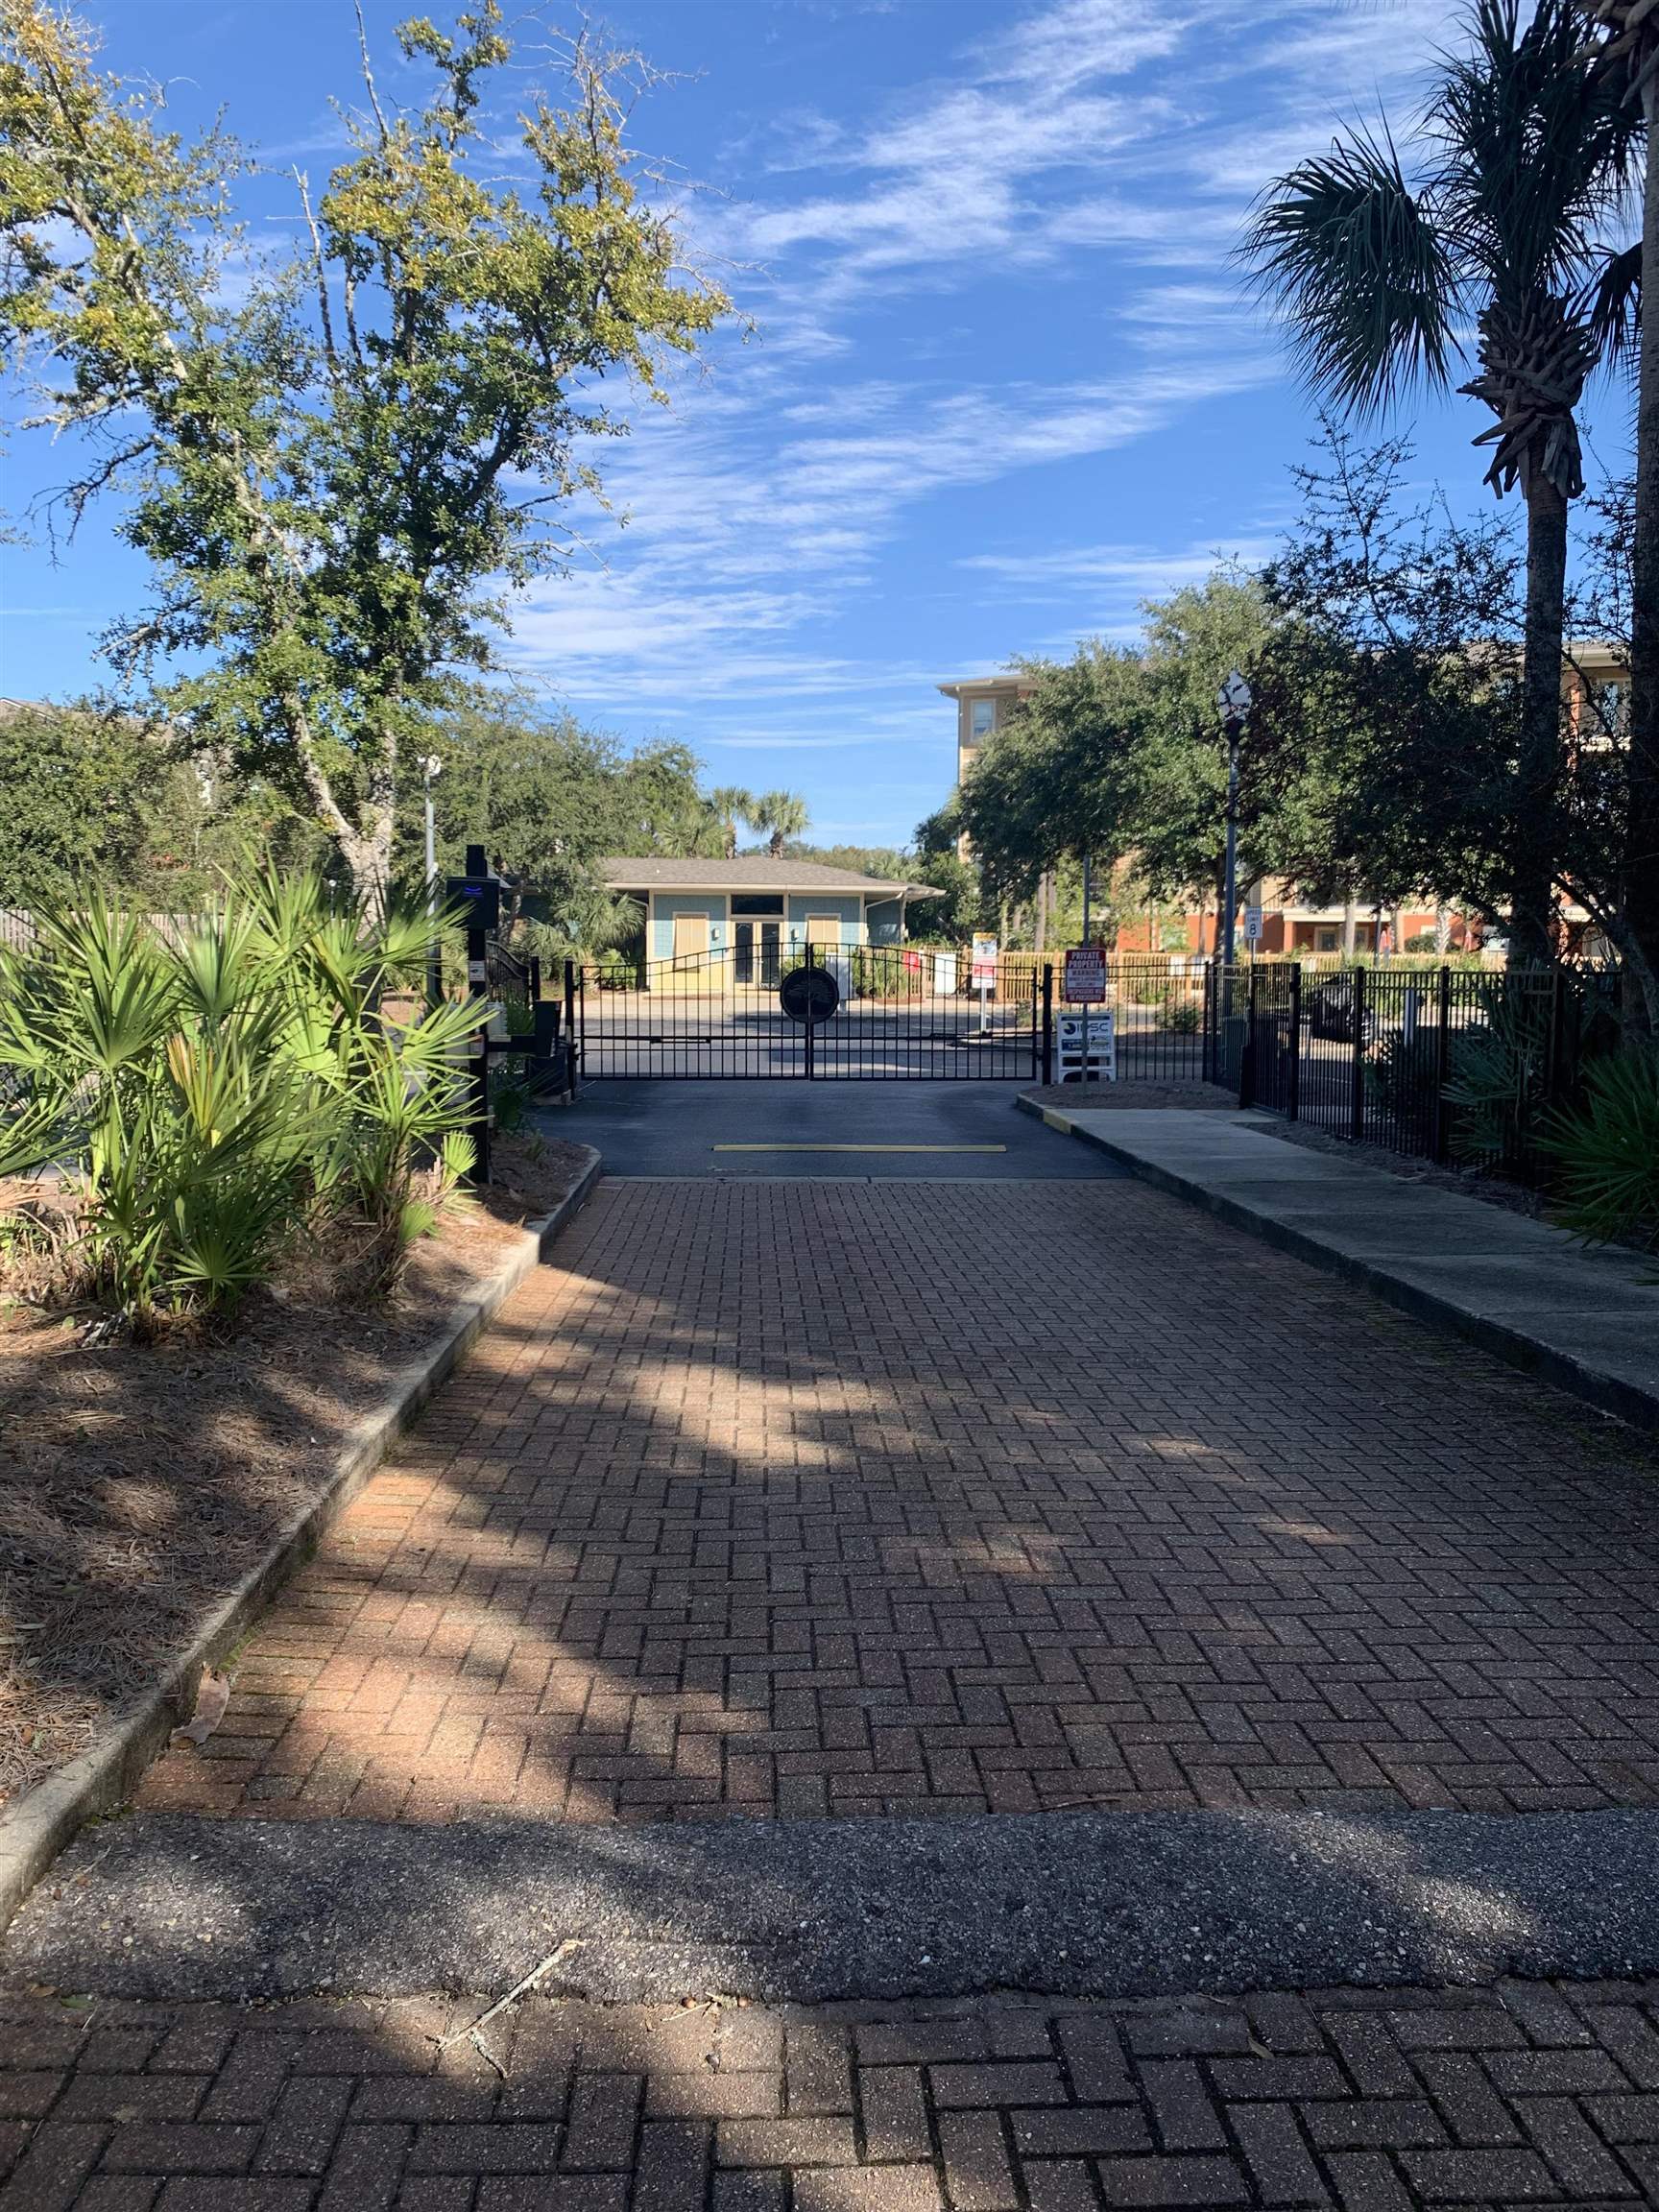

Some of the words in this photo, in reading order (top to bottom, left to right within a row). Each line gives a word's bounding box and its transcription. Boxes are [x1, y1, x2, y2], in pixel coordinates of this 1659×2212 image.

[1249, 924, 1257, 936] 8
[1071, 951, 1100, 960] PRIVATE
[1068, 960, 1103, 969] PROPERTY
